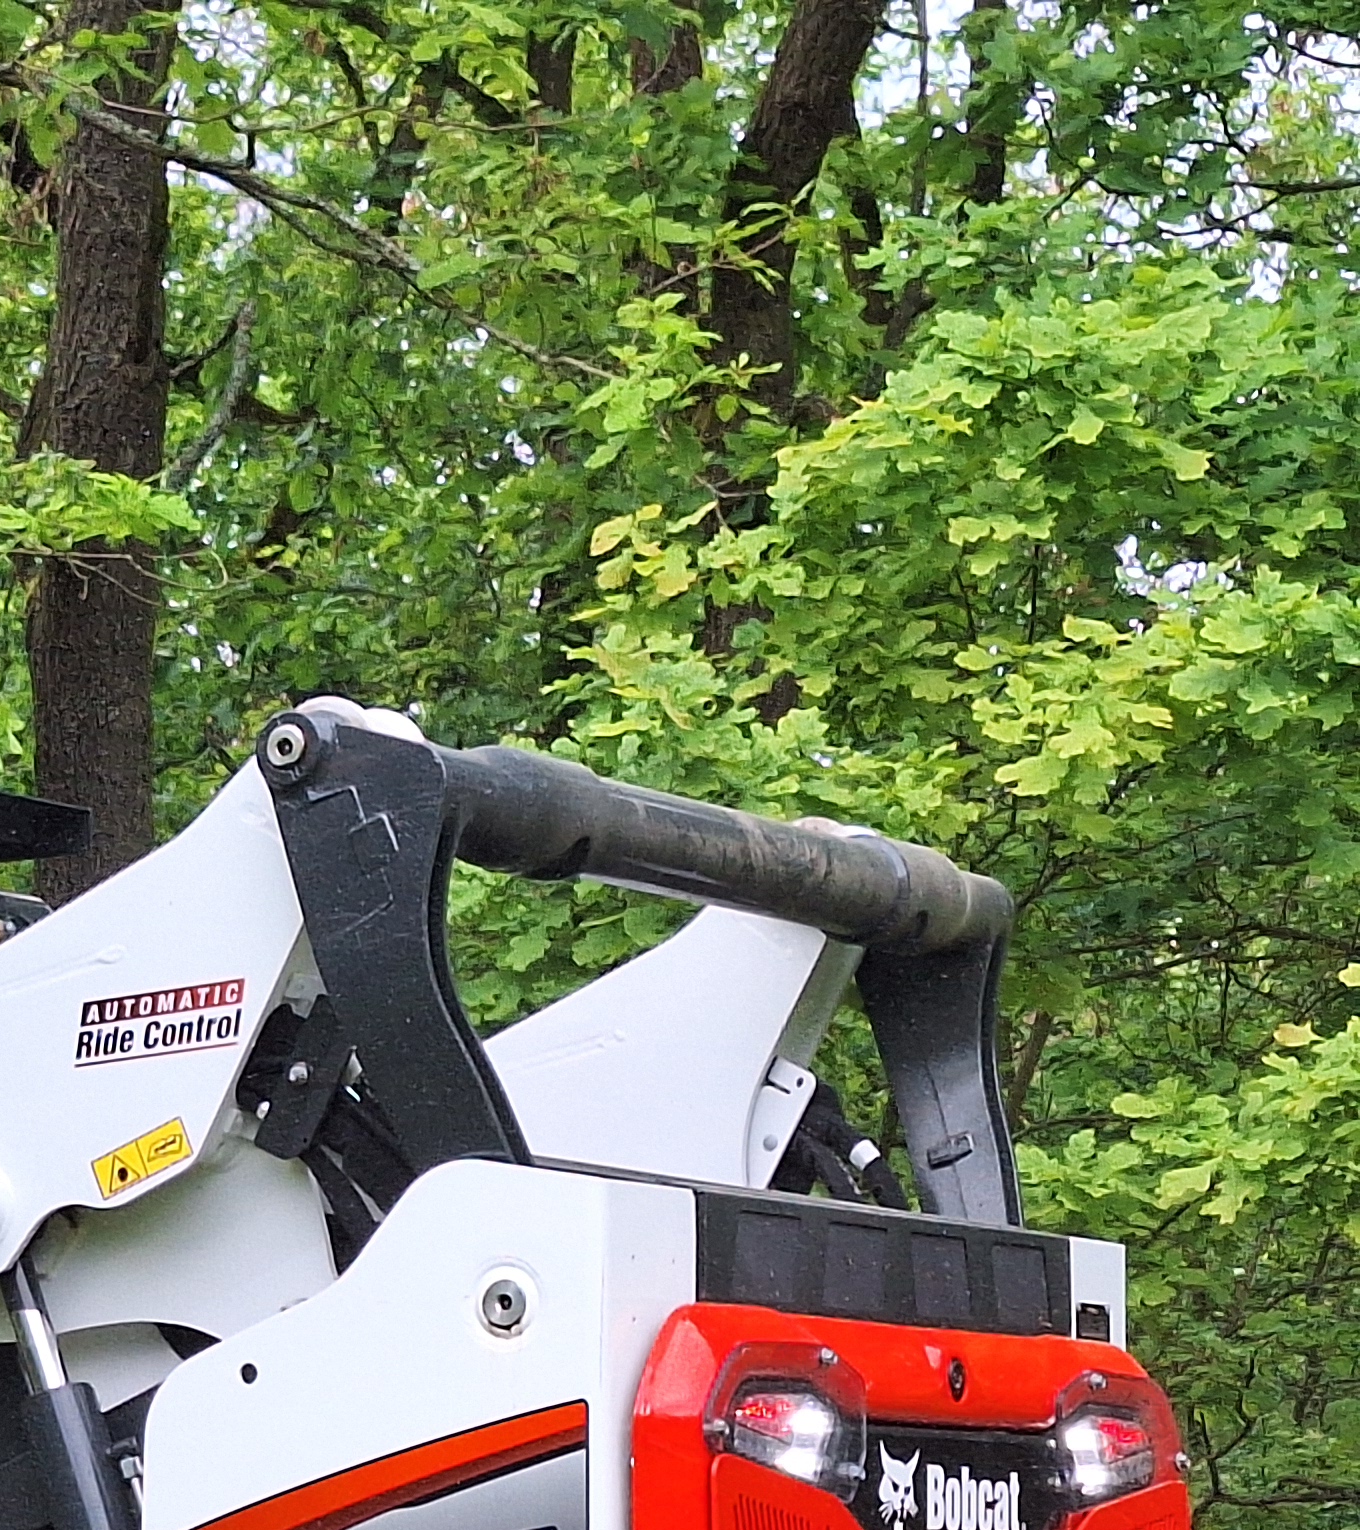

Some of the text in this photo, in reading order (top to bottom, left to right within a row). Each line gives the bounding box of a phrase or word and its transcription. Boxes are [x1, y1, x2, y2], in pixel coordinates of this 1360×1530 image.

[85, 982, 239, 1024] AUTOMATIC
[75, 1008, 242, 1060] Ride Control
